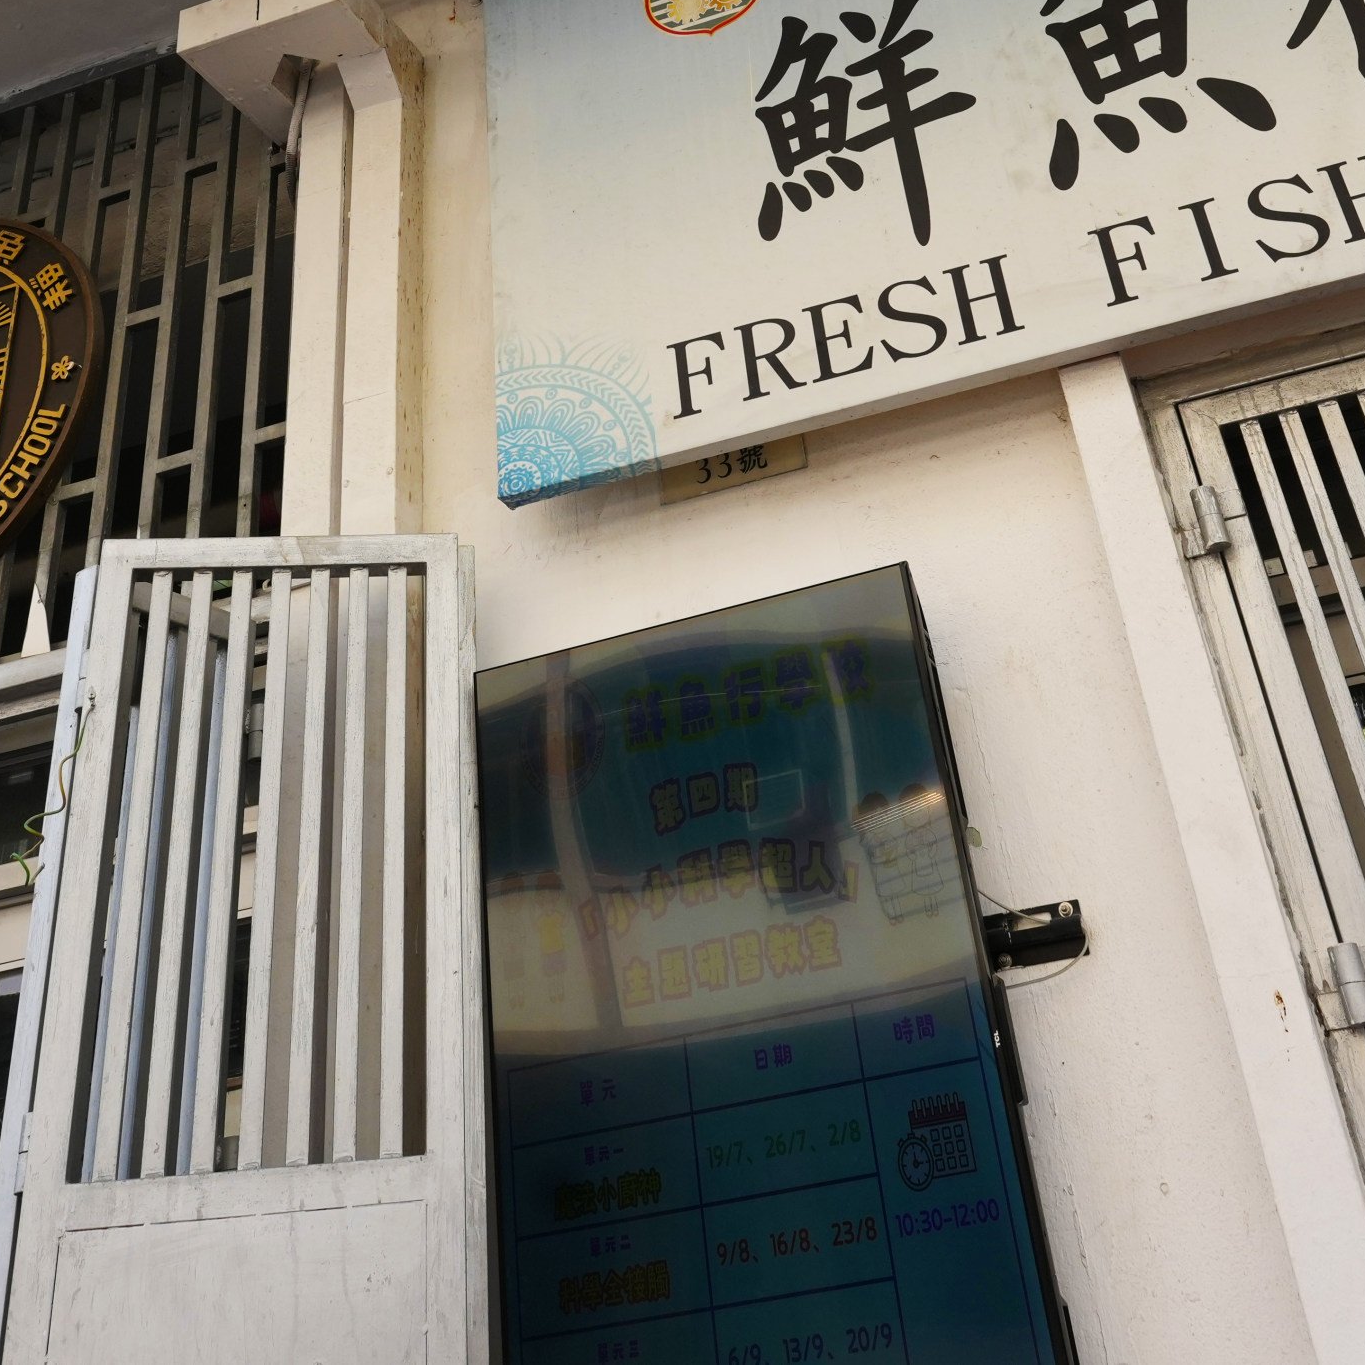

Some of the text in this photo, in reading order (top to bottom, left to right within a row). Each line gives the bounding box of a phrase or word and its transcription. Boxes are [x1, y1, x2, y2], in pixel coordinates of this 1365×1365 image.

[666, 254, 1025, 419] FRESH
[696, 444, 768, 484] 33號
[650, 762, 758, 835] 第四期
[892, 1014, 935, 1045] 時間
[754, 1043, 793, 1070] 日期
[579, 1078, 617, 1107] 單元
[895, 1198, 1000, 1238] 10:30-12:00
